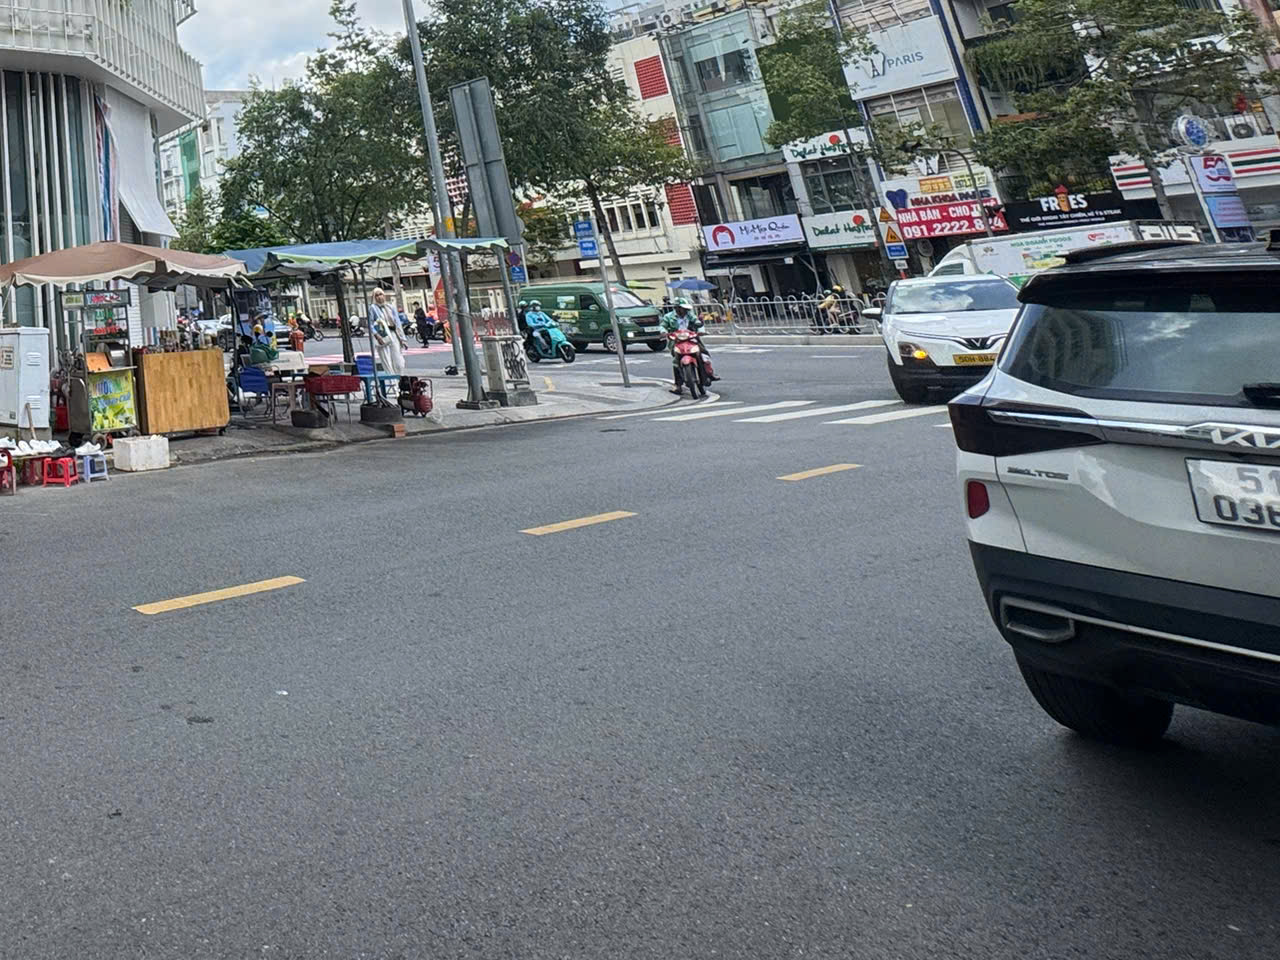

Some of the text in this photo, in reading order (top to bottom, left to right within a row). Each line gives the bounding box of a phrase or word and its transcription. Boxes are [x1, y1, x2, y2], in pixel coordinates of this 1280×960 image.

[887, 52, 924, 69] PARIS
[910, 196, 932, 207] NHA
[932, 193, 959, 205] KHOA
[898, 210, 919, 223] NHÀ
[919, 207, 941, 222] BÁN
[948, 205, 969, 218] CHO
[811, 224, 841, 237] Dalat
